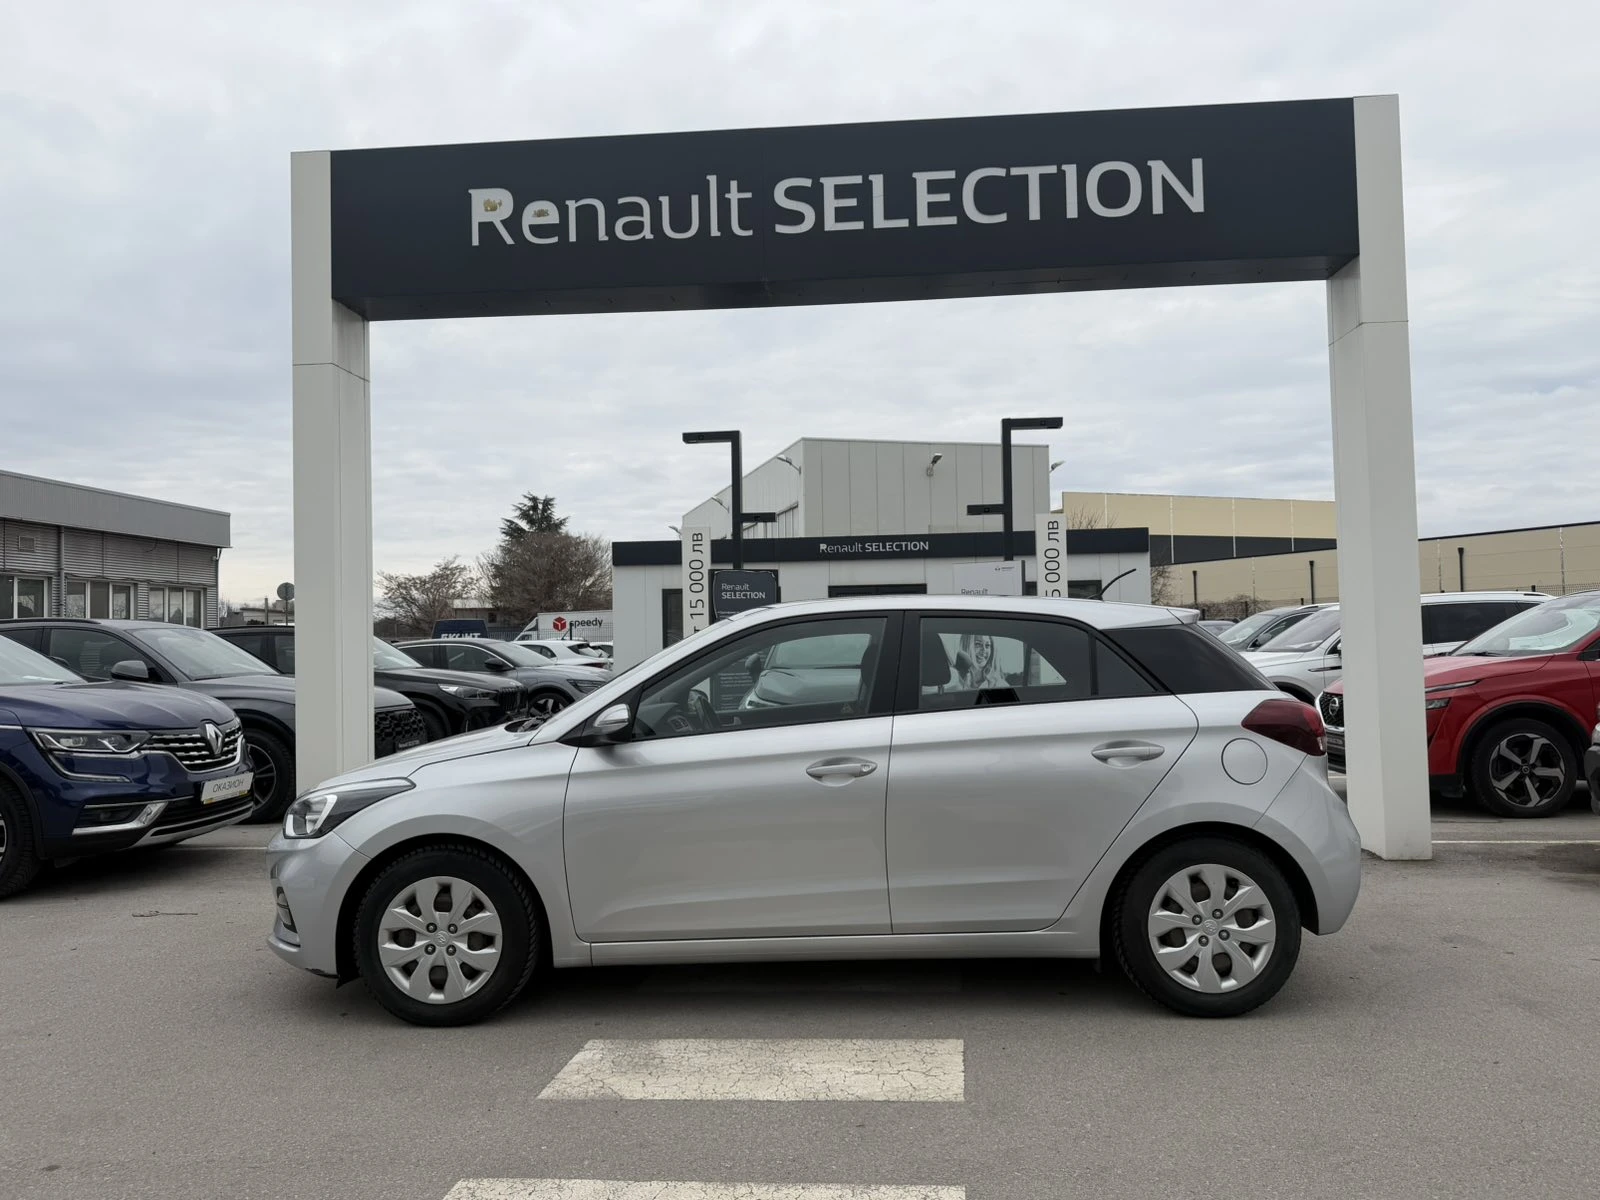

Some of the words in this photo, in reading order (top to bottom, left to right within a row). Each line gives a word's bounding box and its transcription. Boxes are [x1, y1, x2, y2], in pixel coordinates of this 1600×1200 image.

[468, 174, 753, 246] Renault
[773, 157, 1205, 234] SELECTION
[1047, 520, 1060, 543] лв
[691, 532, 703, 554] лв
[819, 542, 863, 553] Renault
[865, 541, 929, 552] SELECTION
[1044, 548, 1061, 583] 000
[688, 559, 704, 594] 000
[721, 583, 750, 591] Renault
[721, 591, 766, 599] SELECTION
[689, 599, 704, 620] 15
[569, 617, 603, 628] speedy
[212, 778, 244, 793] ОКАЗИОН
